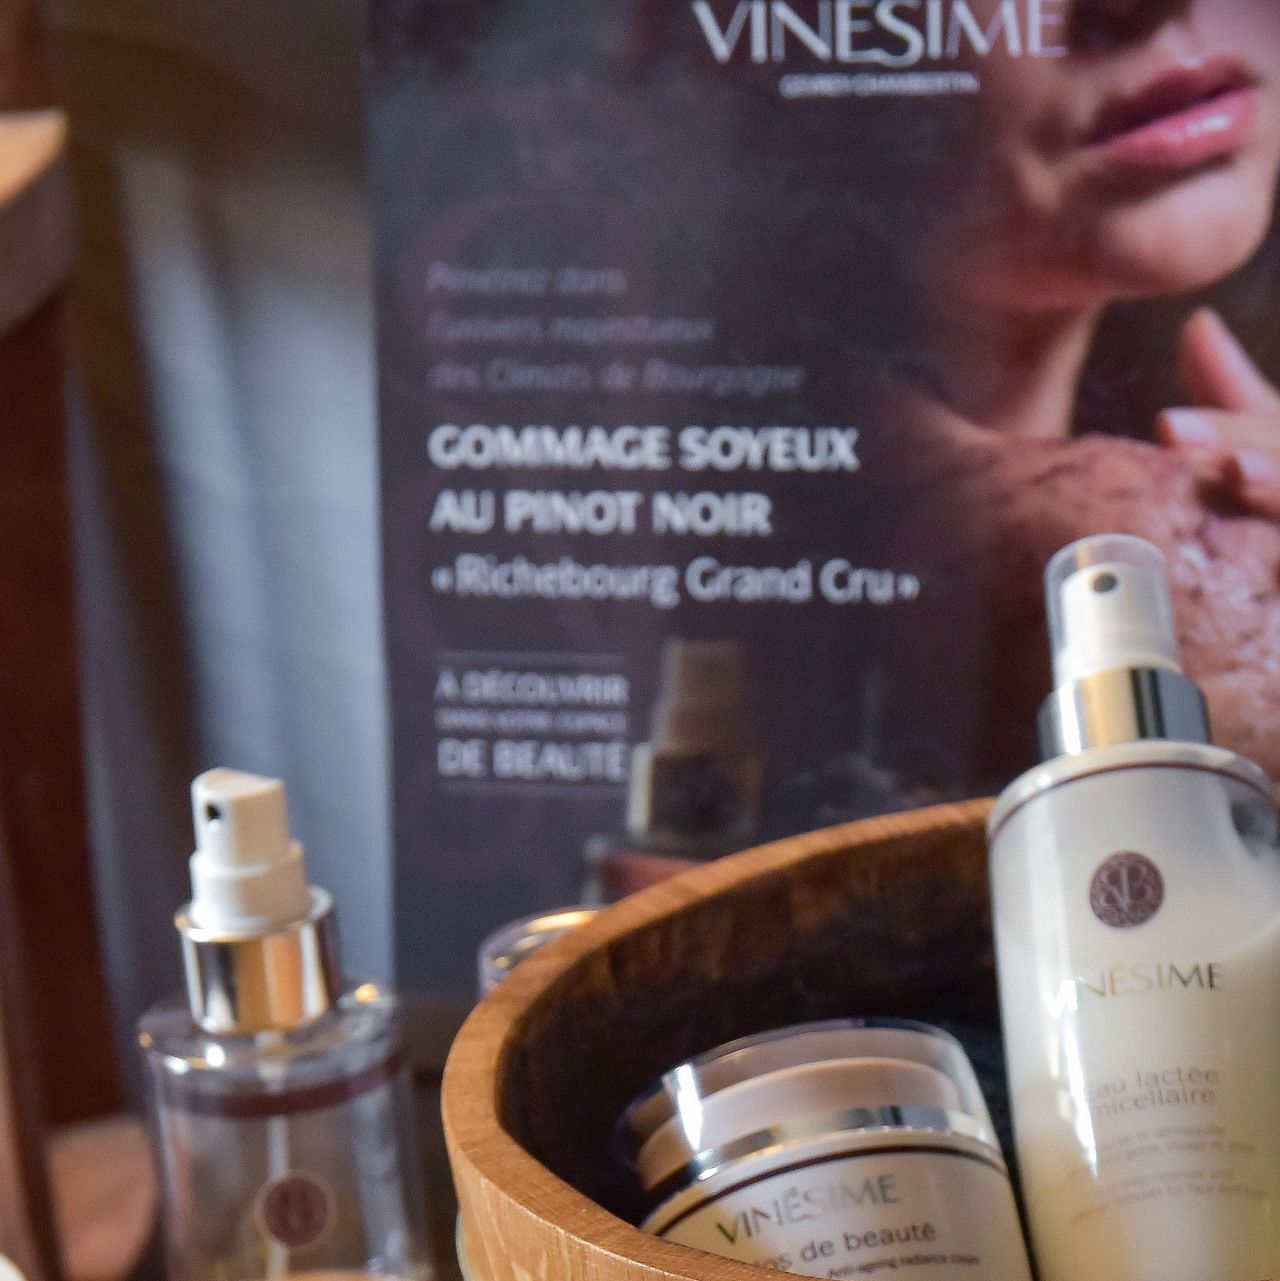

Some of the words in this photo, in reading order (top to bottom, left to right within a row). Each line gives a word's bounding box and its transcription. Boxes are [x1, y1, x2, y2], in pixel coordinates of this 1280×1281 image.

[428, 424, 671, 470] GOMMAGE
[679, 427, 860, 471] SOYEUX
[430, 489, 495, 533] AU
[504, 490, 642, 535] PINOT
[652, 492, 773, 536] NOIR
[685, 557, 813, 602] Grand
[437, 737, 488, 779] DE
[800, 1240, 835, 1262] de
[843, 1221, 936, 1251] beauté
